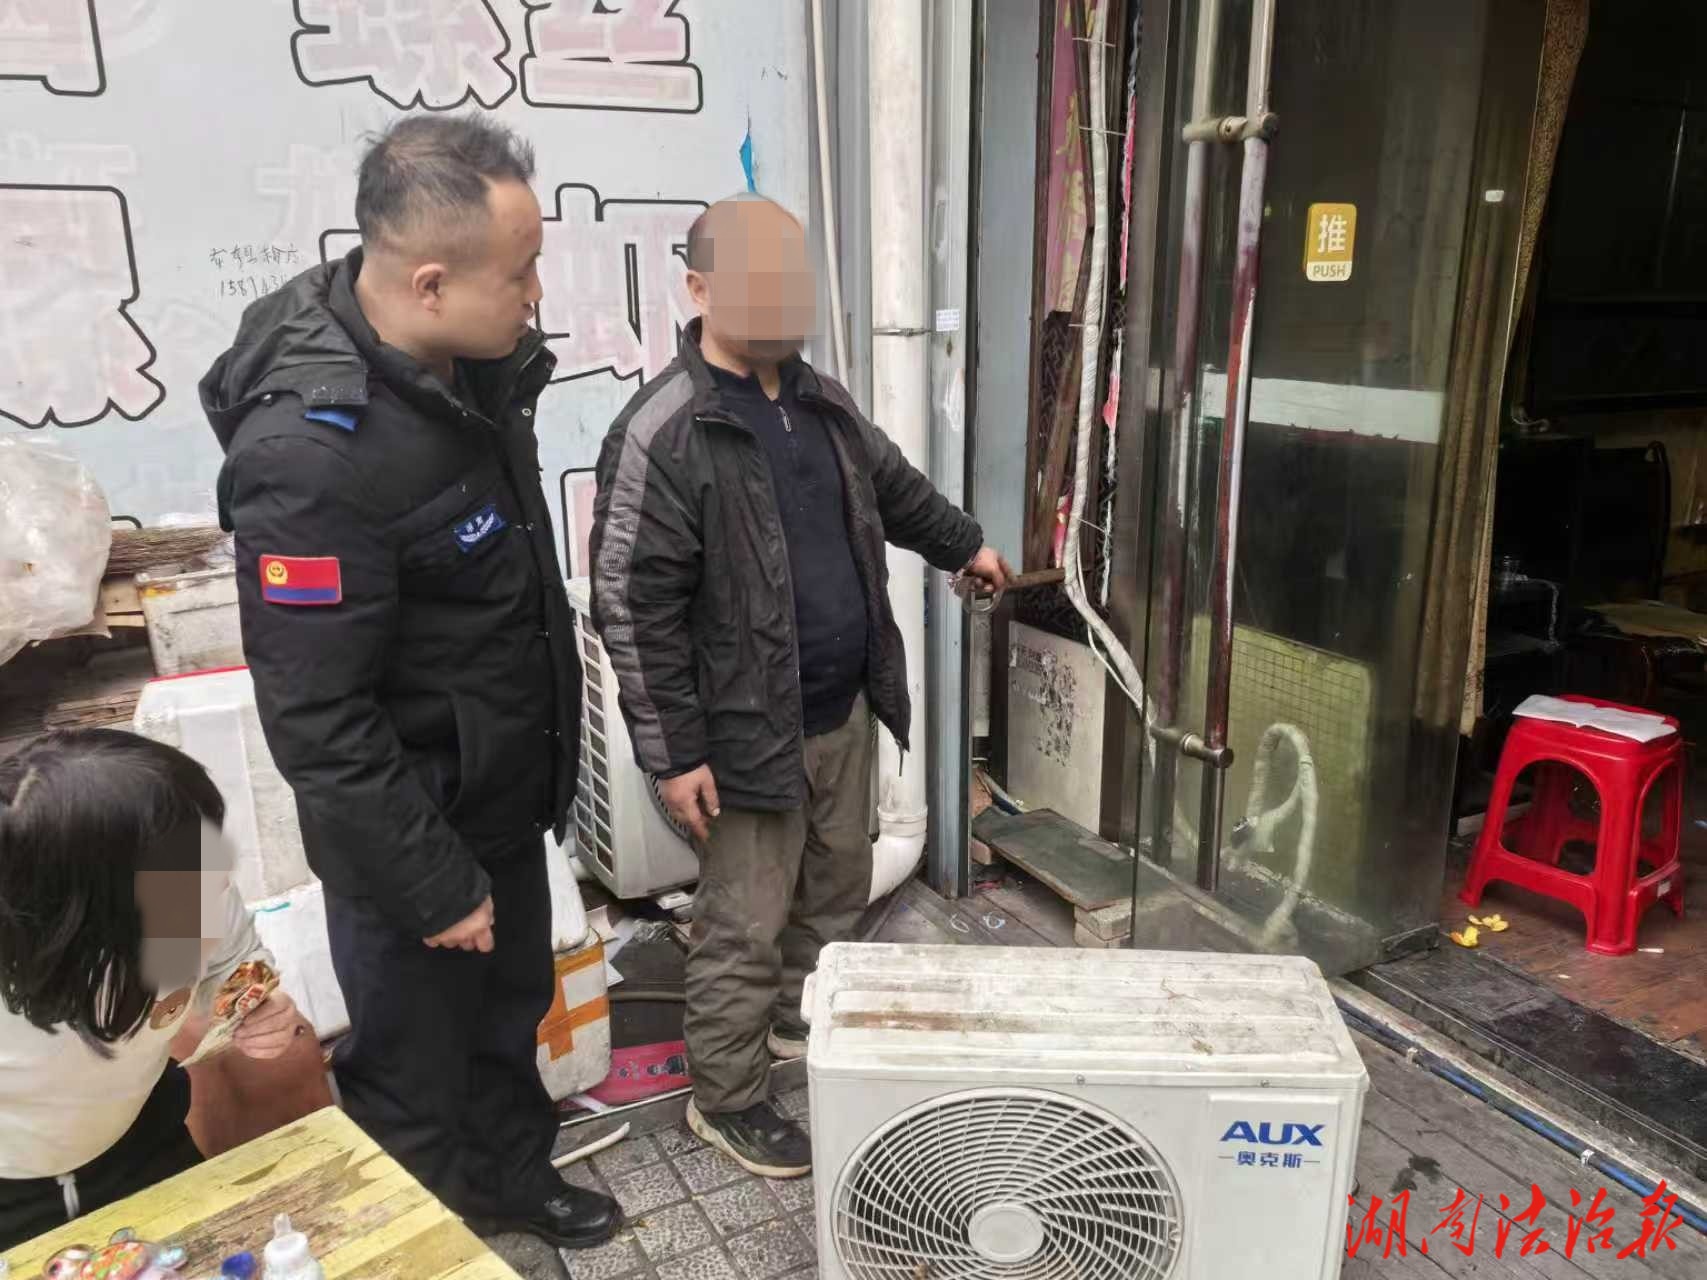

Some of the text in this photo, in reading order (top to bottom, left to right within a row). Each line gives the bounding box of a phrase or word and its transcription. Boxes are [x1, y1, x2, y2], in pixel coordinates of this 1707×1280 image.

[1317, 213, 1348, 253] 推
[1313, 265, 1347, 278] PUSH
[1220, 1120, 1326, 1146] AUX
[1237, 1150, 1303, 1168] 奥克斯
